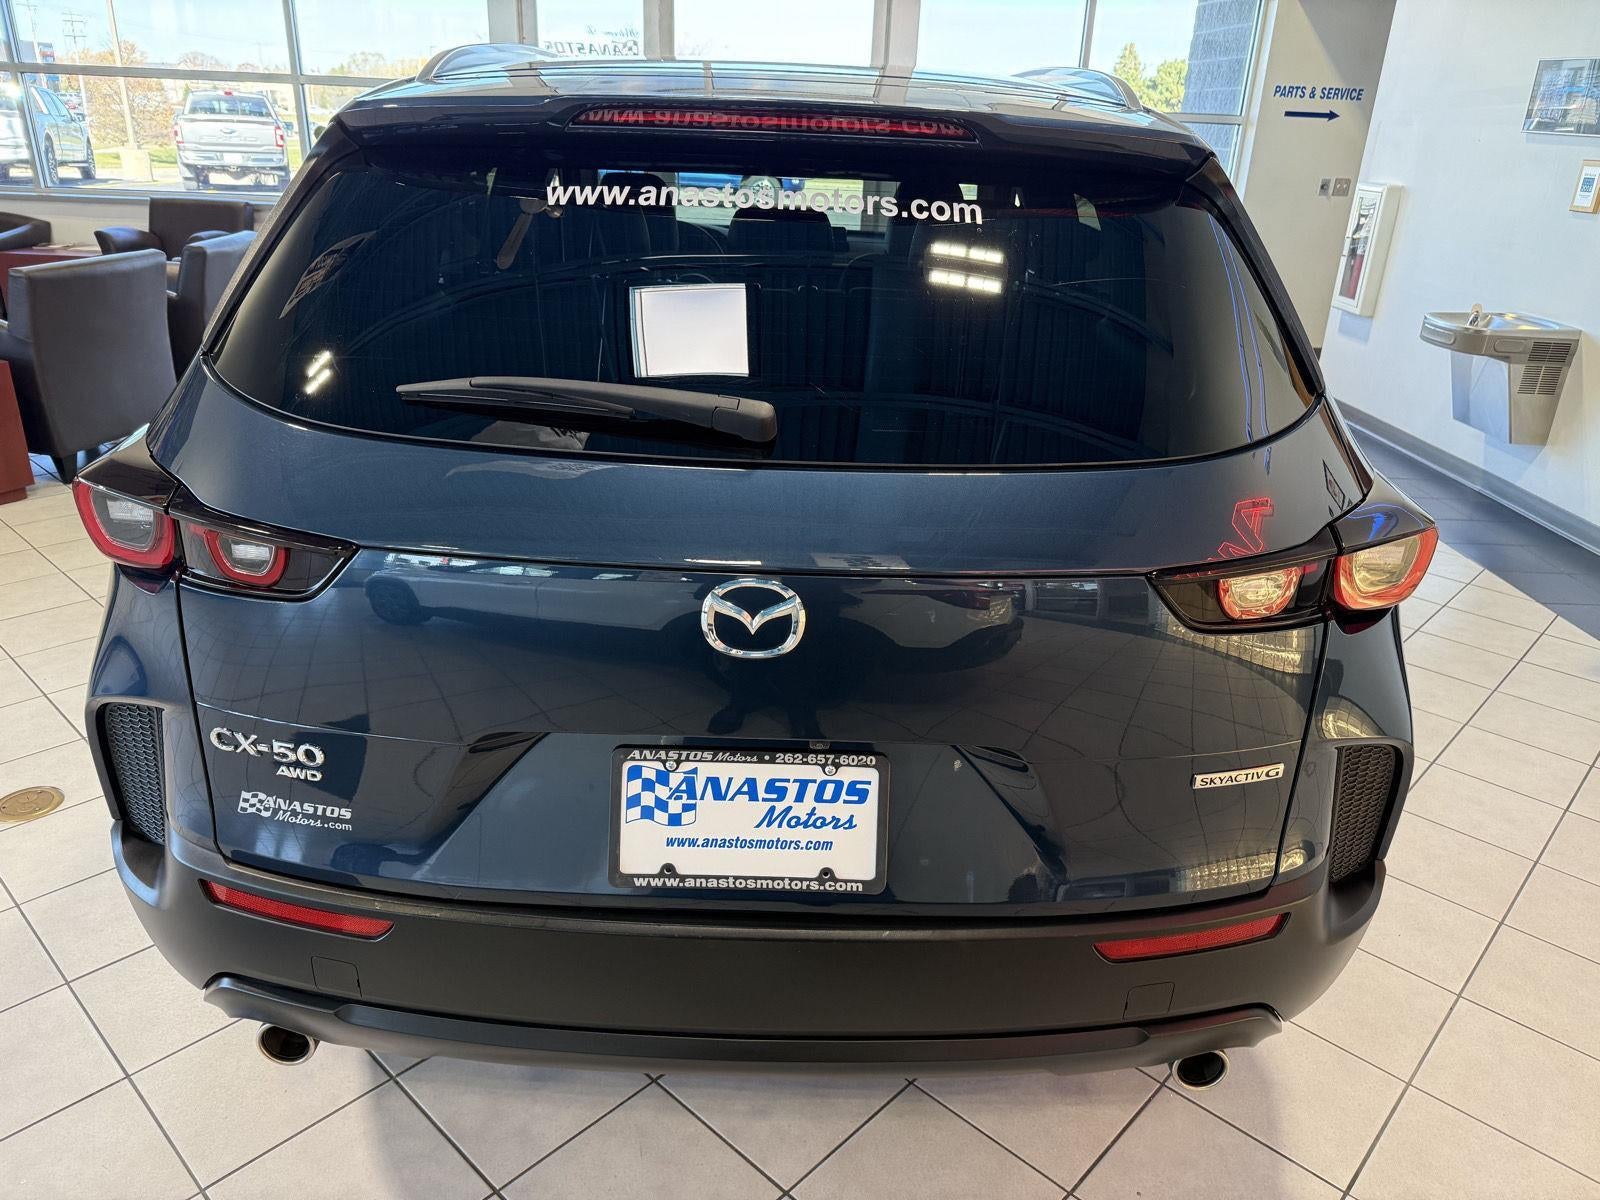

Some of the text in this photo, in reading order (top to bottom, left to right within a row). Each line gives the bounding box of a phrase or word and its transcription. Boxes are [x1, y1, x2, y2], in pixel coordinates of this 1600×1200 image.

[1273, 85, 1365, 101] PARTS & SERVICE
[547, 183, 983, 225] www.anastosmotors.com
[209, 727, 325, 767] CX-50
[627, 750, 876, 766] ANASTOS Motors 262-657-6020
[276, 765, 323, 782] AWD
[667, 775, 872, 805] ANASTOS
[261, 795, 352, 820] ANASTOS
[753, 805, 858, 830] Motors
[665, 835, 834, 851] www.anastosmotors.com
[633, 876, 864, 892] www.anastosmotors.com
